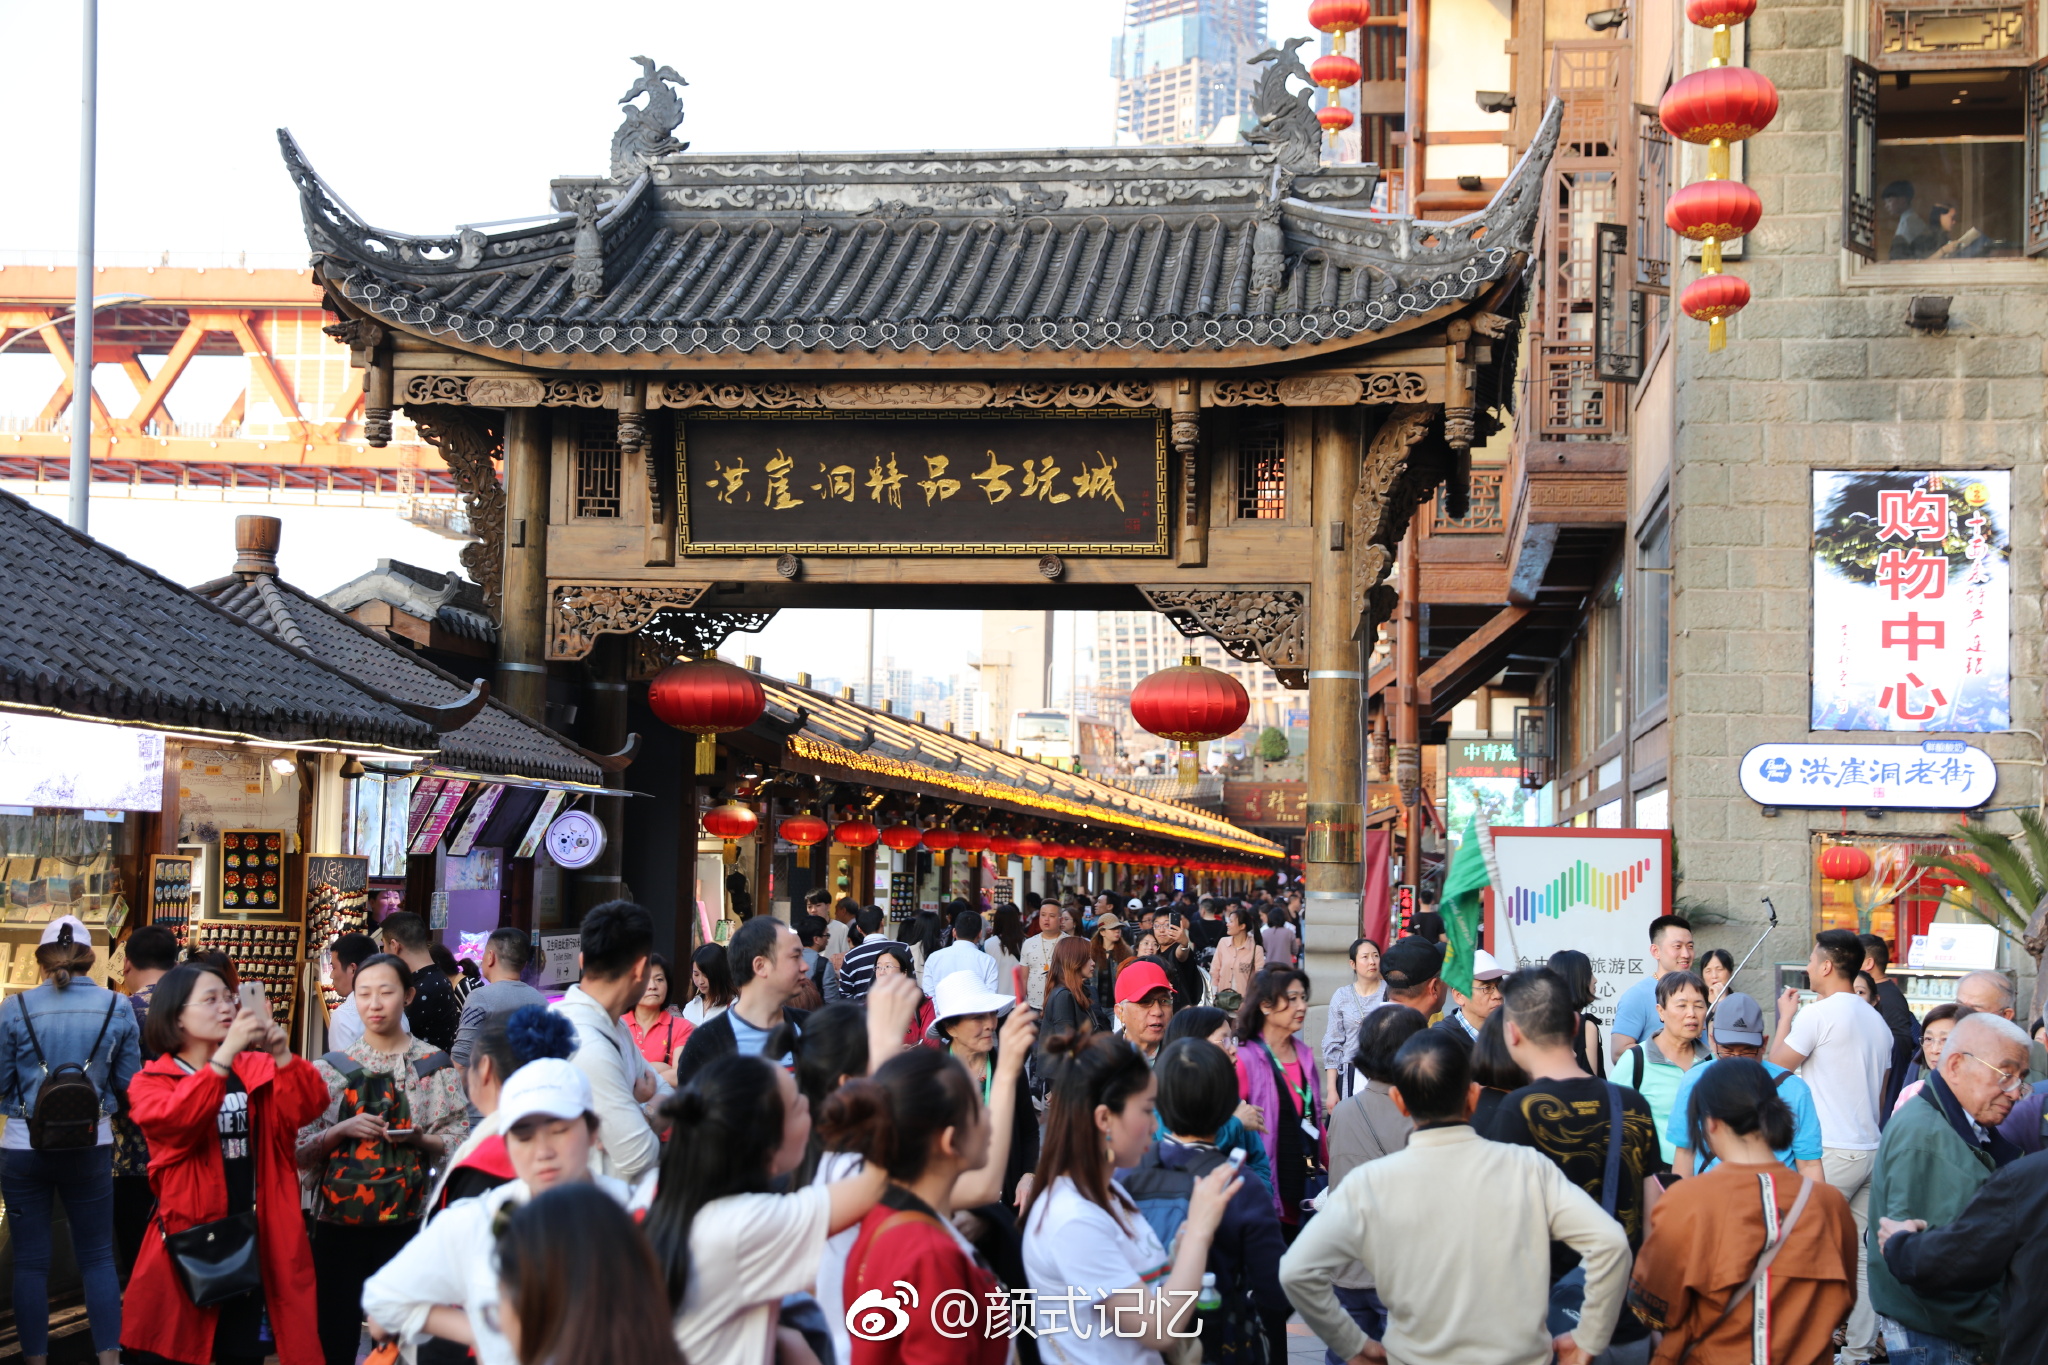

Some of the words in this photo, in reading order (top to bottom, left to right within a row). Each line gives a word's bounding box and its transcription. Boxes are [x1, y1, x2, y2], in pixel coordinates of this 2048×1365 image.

[705, 448, 1124, 512] 洪崖洞精品古玩城
[1878, 490, 1948, 721] 购物中心
[1463, 743, 1518, 761] 中青旅
[1800, 756, 1975, 793] 洪崖洞老街
